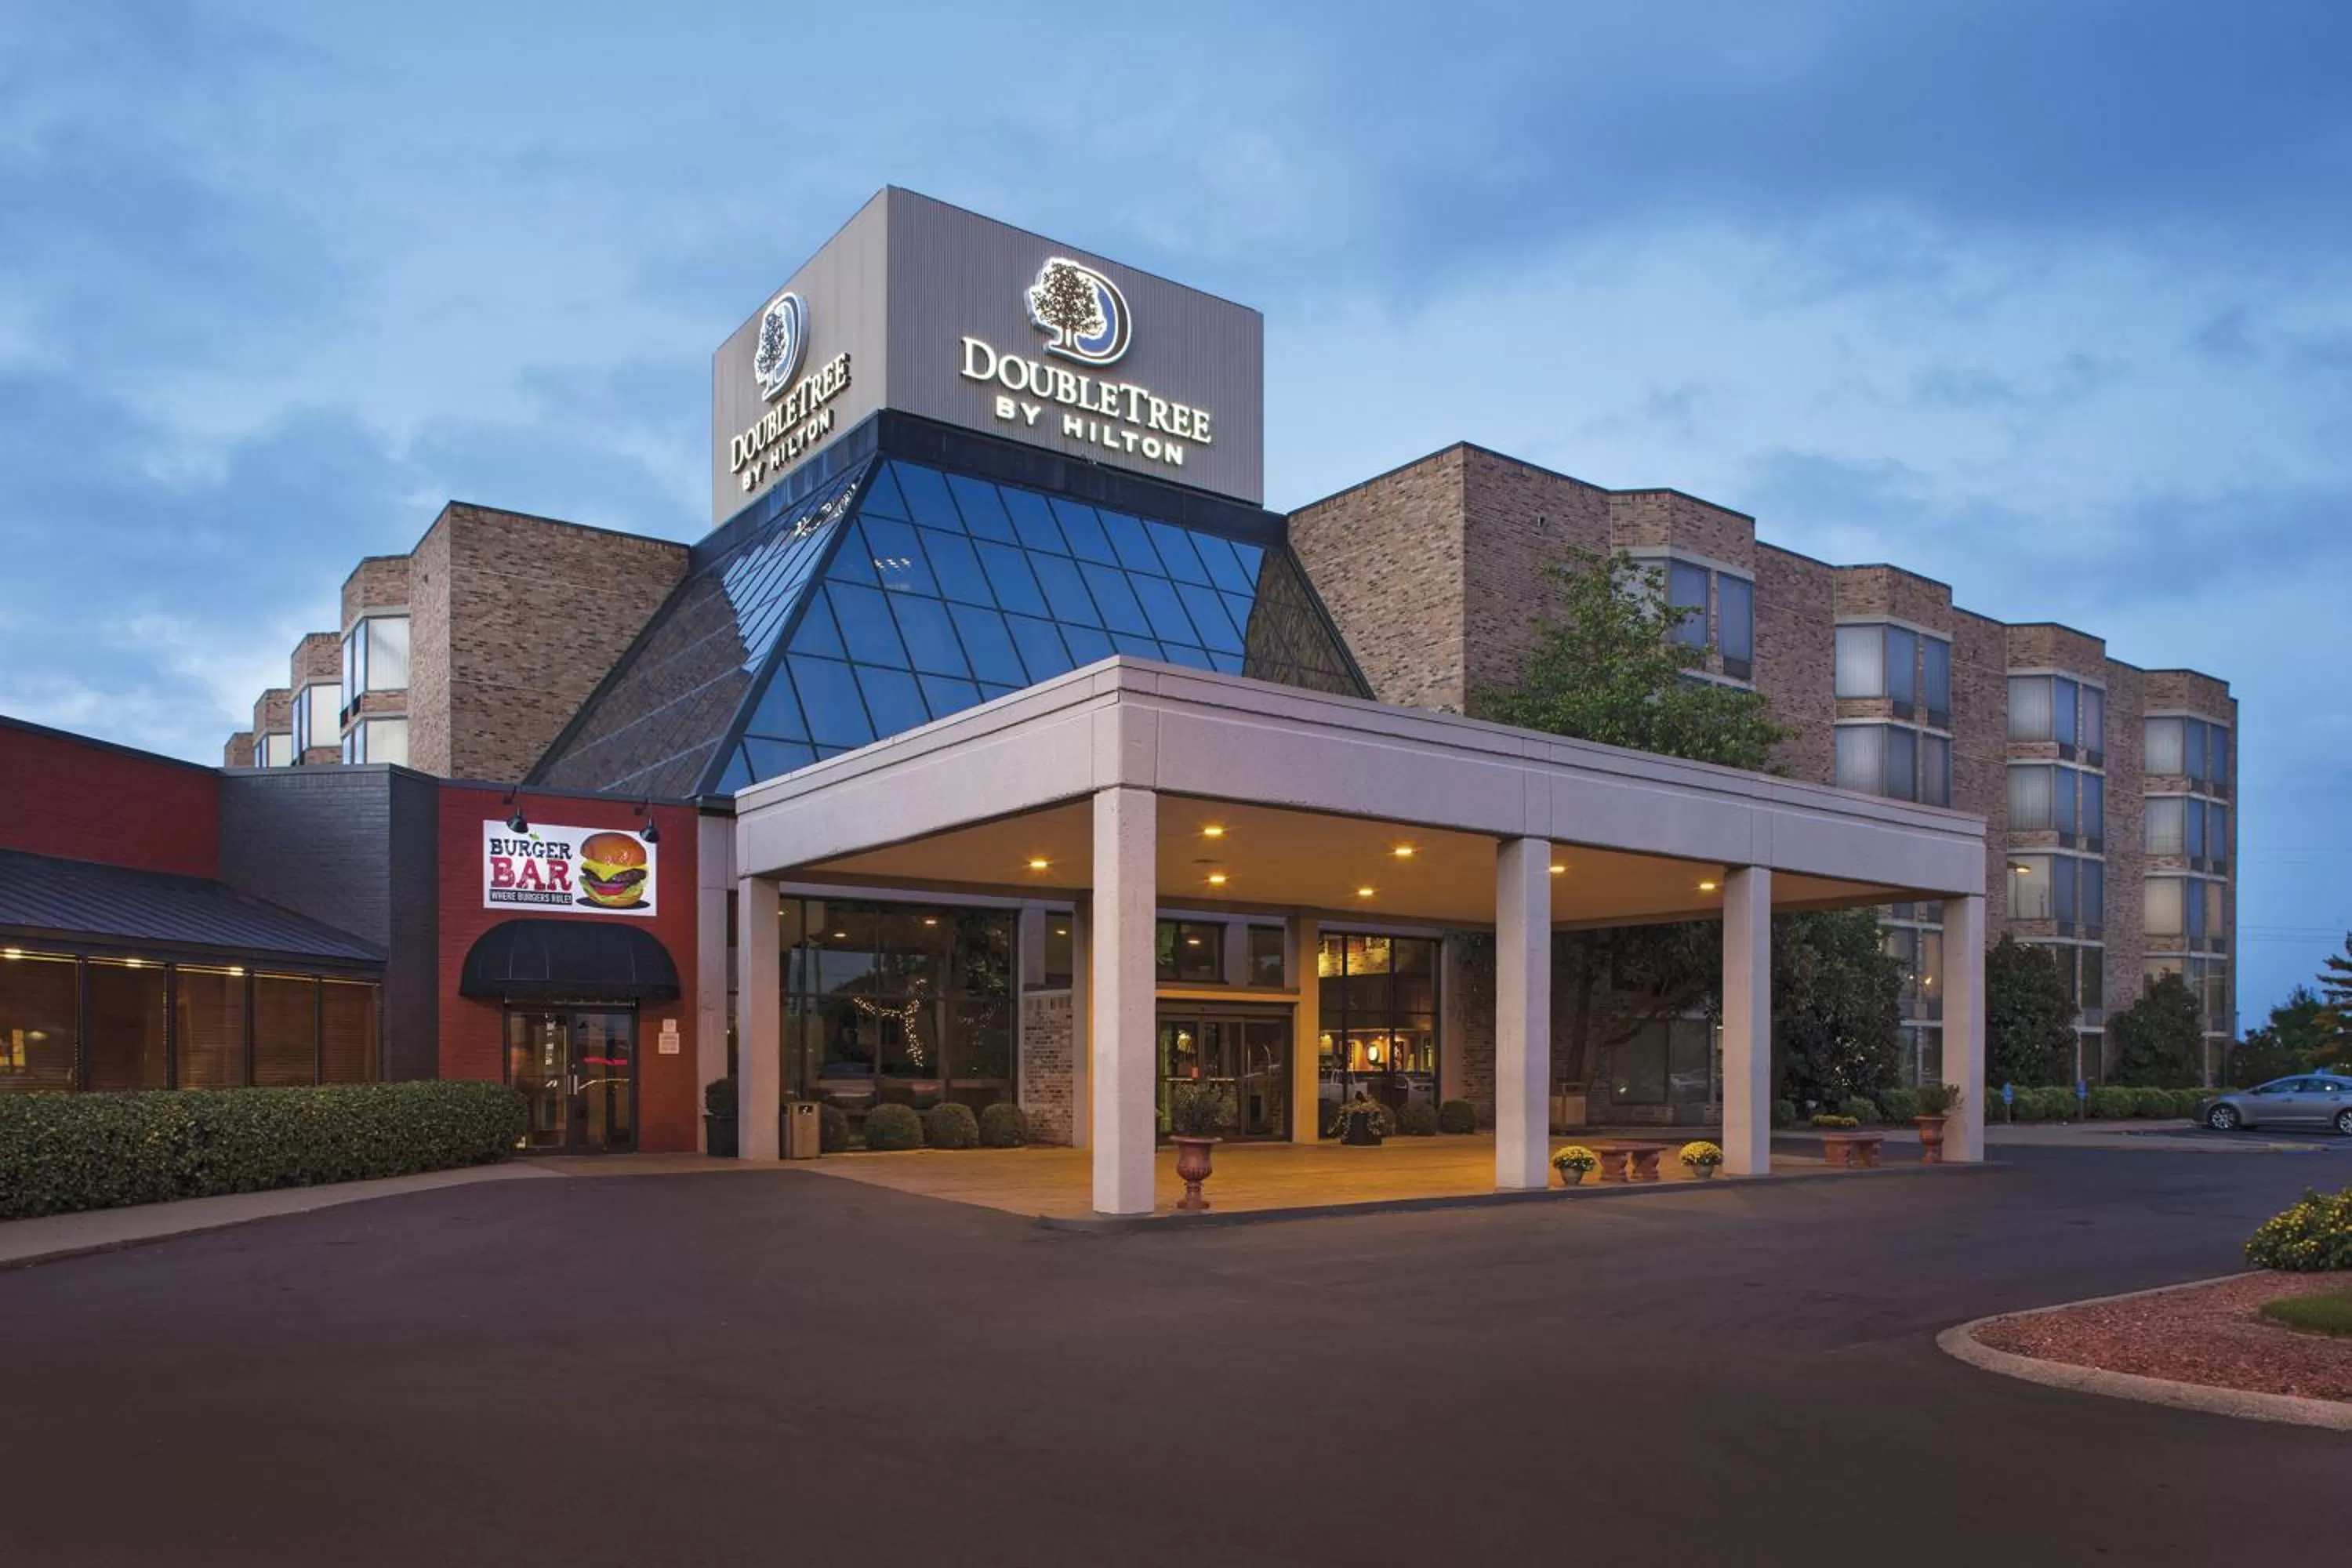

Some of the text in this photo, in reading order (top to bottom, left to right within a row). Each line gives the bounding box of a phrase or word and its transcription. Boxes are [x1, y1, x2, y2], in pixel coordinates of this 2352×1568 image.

[743, 408, 833, 491] BY HILTON
[996, 396, 1184, 466] BY HILTON
[490, 838, 572, 860] BURGER
[490, 857, 572, 891] BAR
